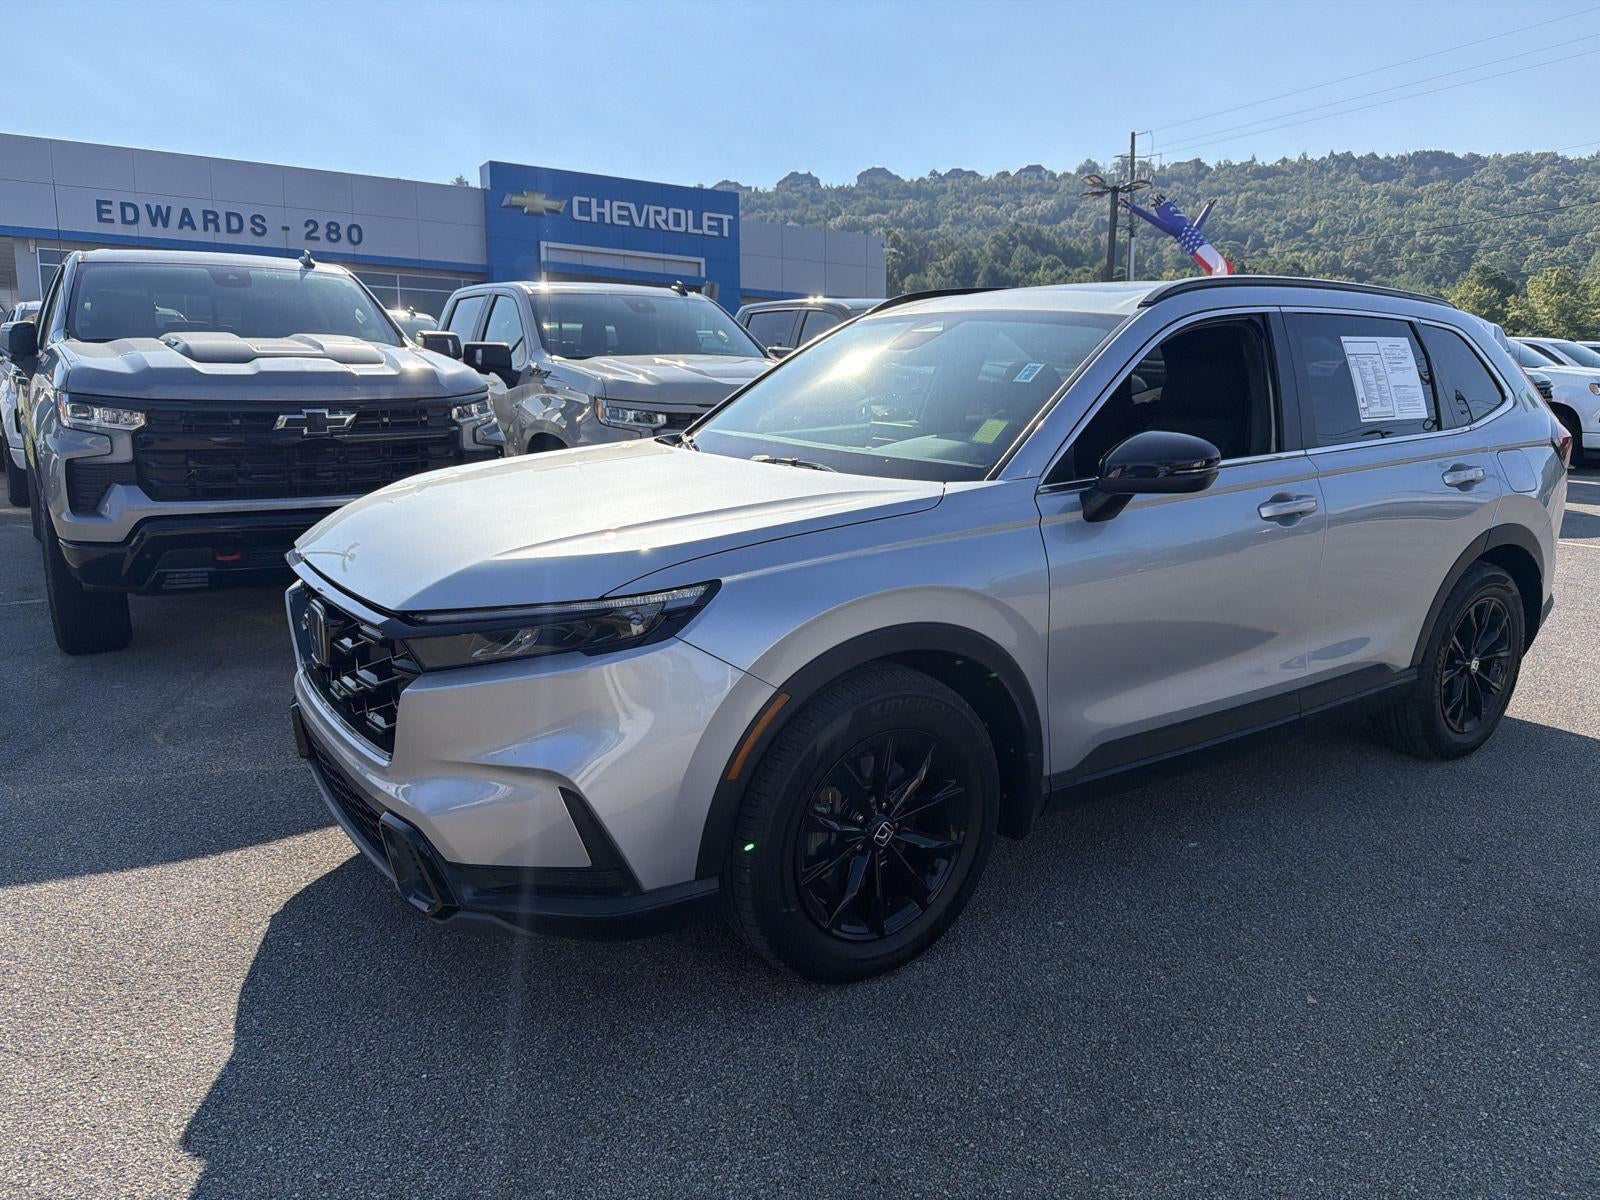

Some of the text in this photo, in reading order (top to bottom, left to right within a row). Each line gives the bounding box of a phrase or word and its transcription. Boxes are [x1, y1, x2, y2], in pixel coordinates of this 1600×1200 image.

[95, 199, 268, 237] EDWARDS
[303, 218, 364, 246] 280
[572, 195, 734, 238] CHEVROLET
